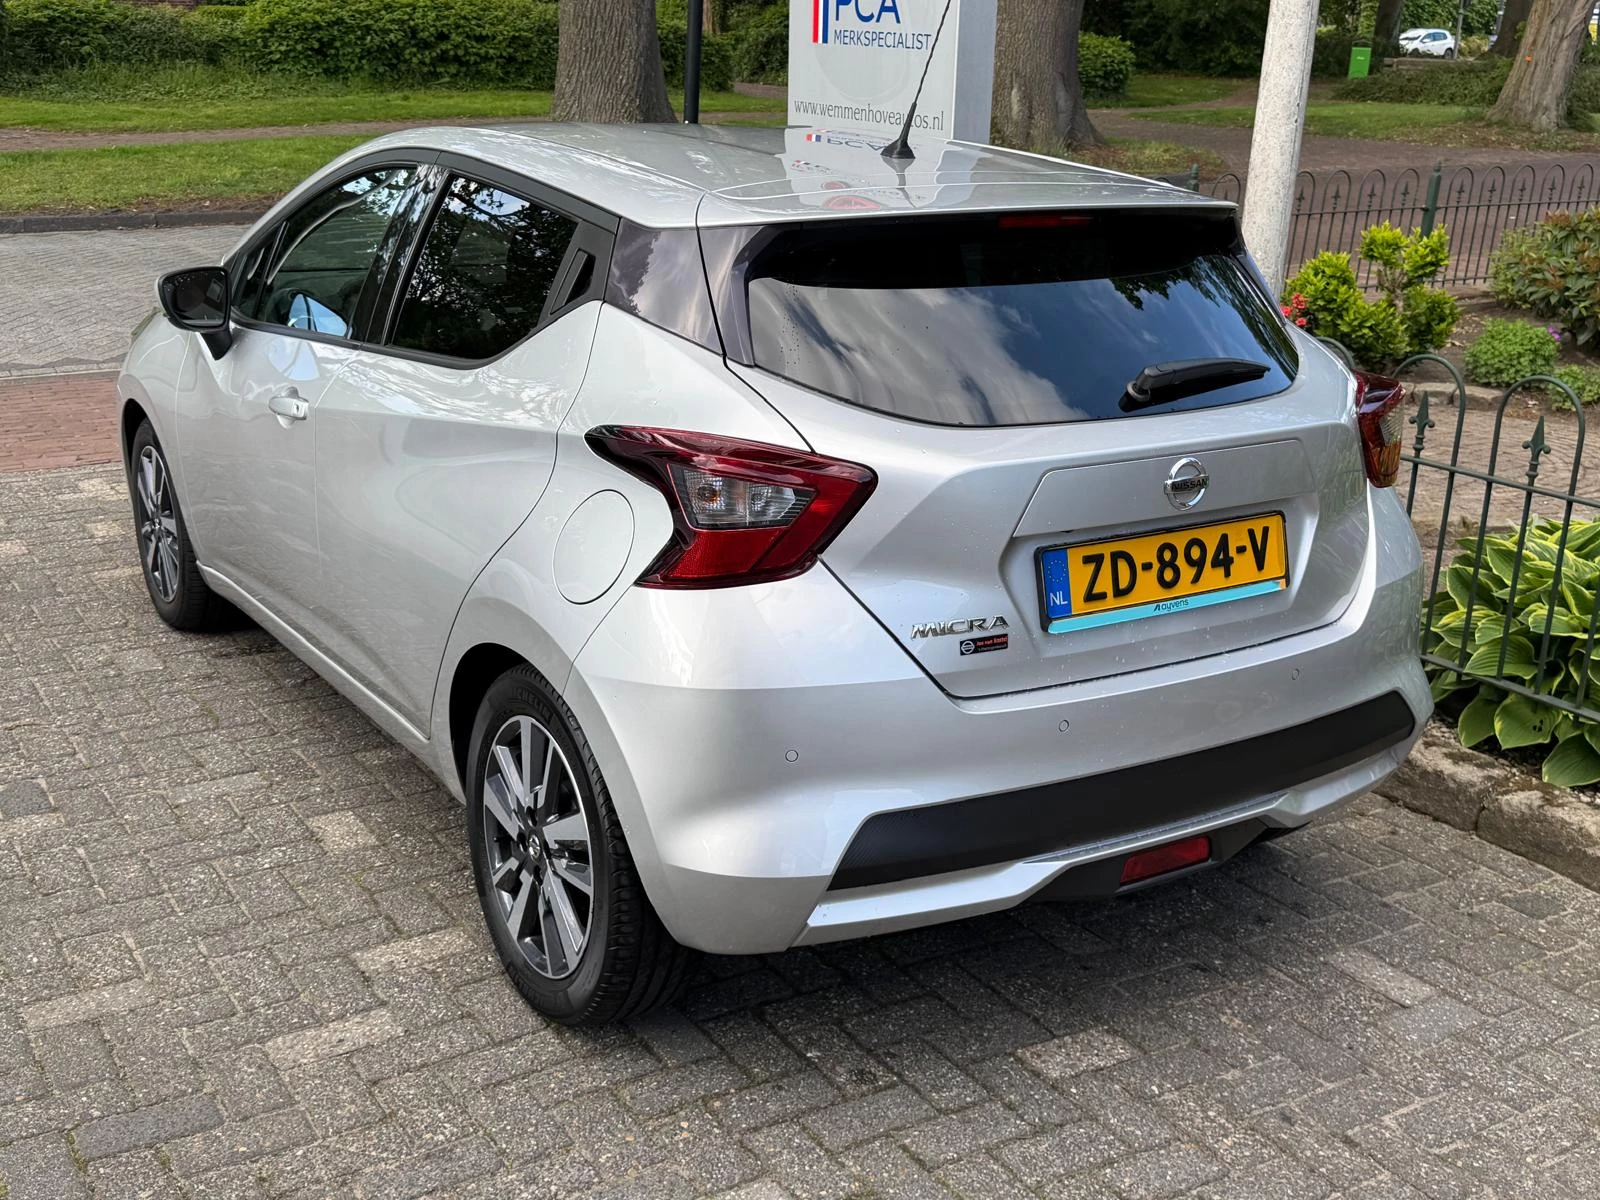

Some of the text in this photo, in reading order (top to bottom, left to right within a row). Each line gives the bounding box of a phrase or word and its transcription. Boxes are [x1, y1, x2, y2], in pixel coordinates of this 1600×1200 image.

[835, 0, 901, 24] PCA
[834, 29, 932, 51] MERKSPECIALIST
[794, 101, 944, 131] www.wemmenhoveaos.nl
[1171, 478, 1208, 491] NISSAN
[1081, 525, 1270, 603] ZD-894-V
[1050, 591, 1068, 607] NL
[911, 615, 1009, 639] MICRA
